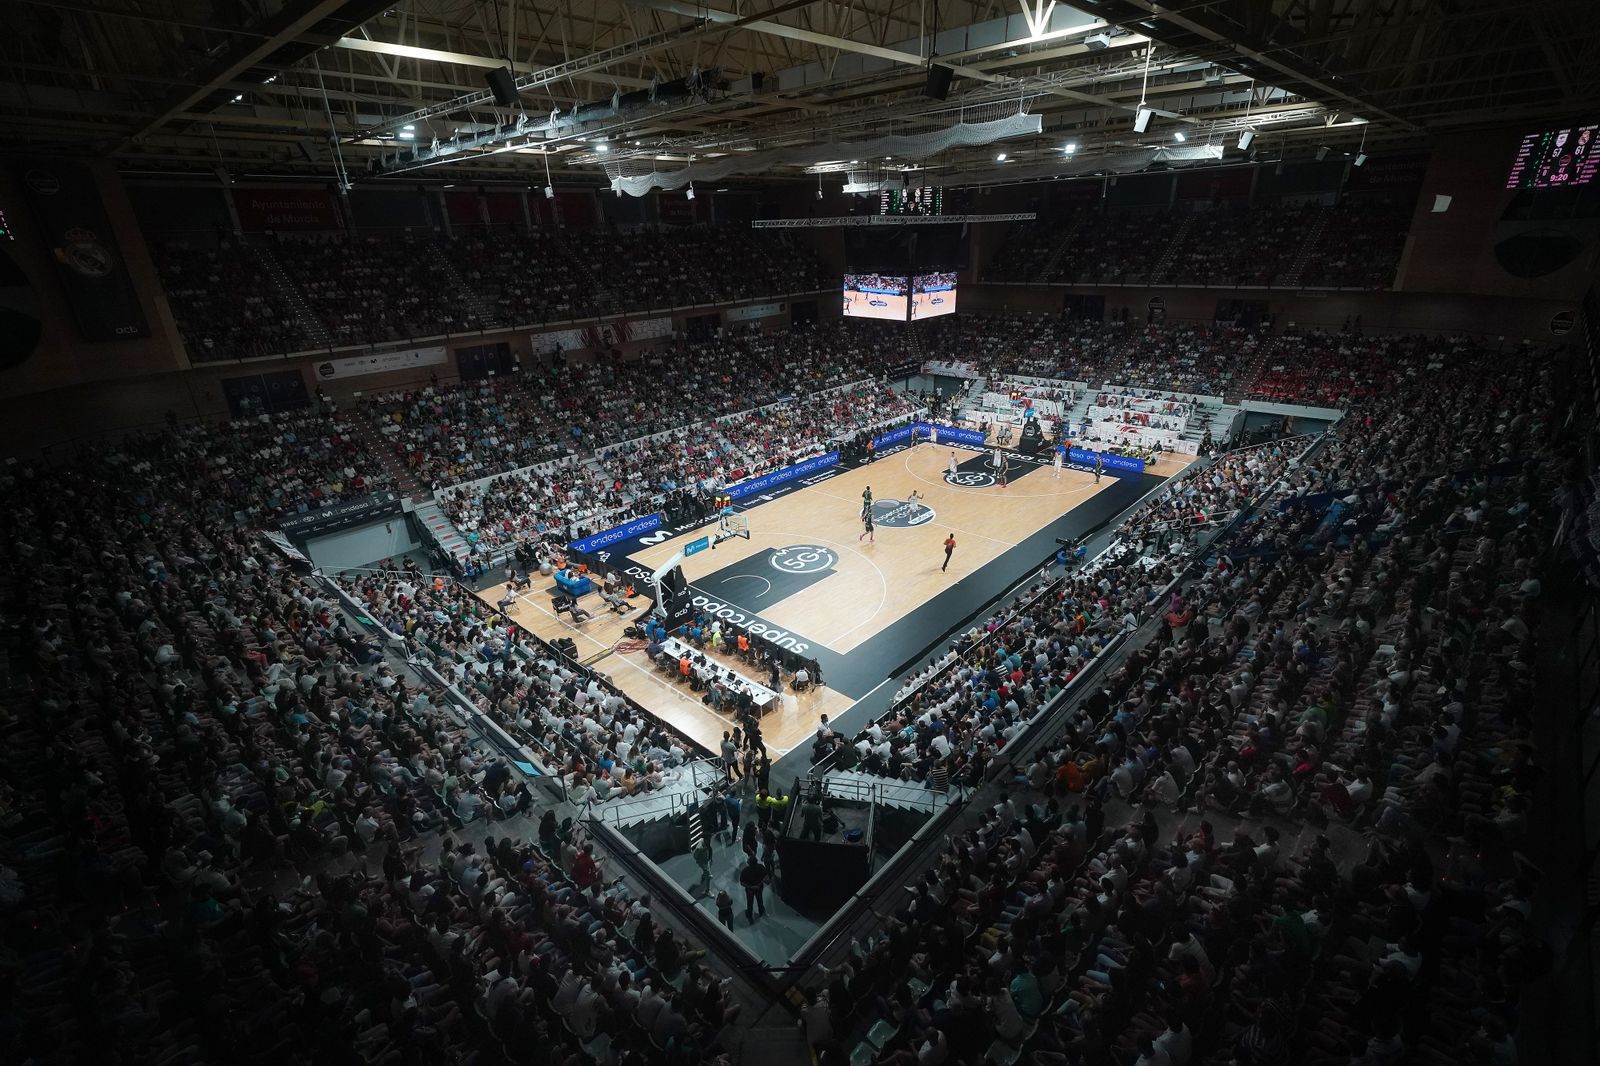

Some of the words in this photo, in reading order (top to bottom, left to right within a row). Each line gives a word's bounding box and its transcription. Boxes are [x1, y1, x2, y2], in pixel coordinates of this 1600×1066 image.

[1552, 148, 1563, 157] 57
[1575, 146, 1585, 155] 61
[1550, 174, 1568, 182] 9:20
[743, 479, 768, 493] endesa
[769, 470, 793, 483] endesa
[794, 461, 817, 475] endesa
[817, 453, 839, 466] endesa
[590, 530, 625, 548] endesa
[627, 518, 658, 535] endesa
